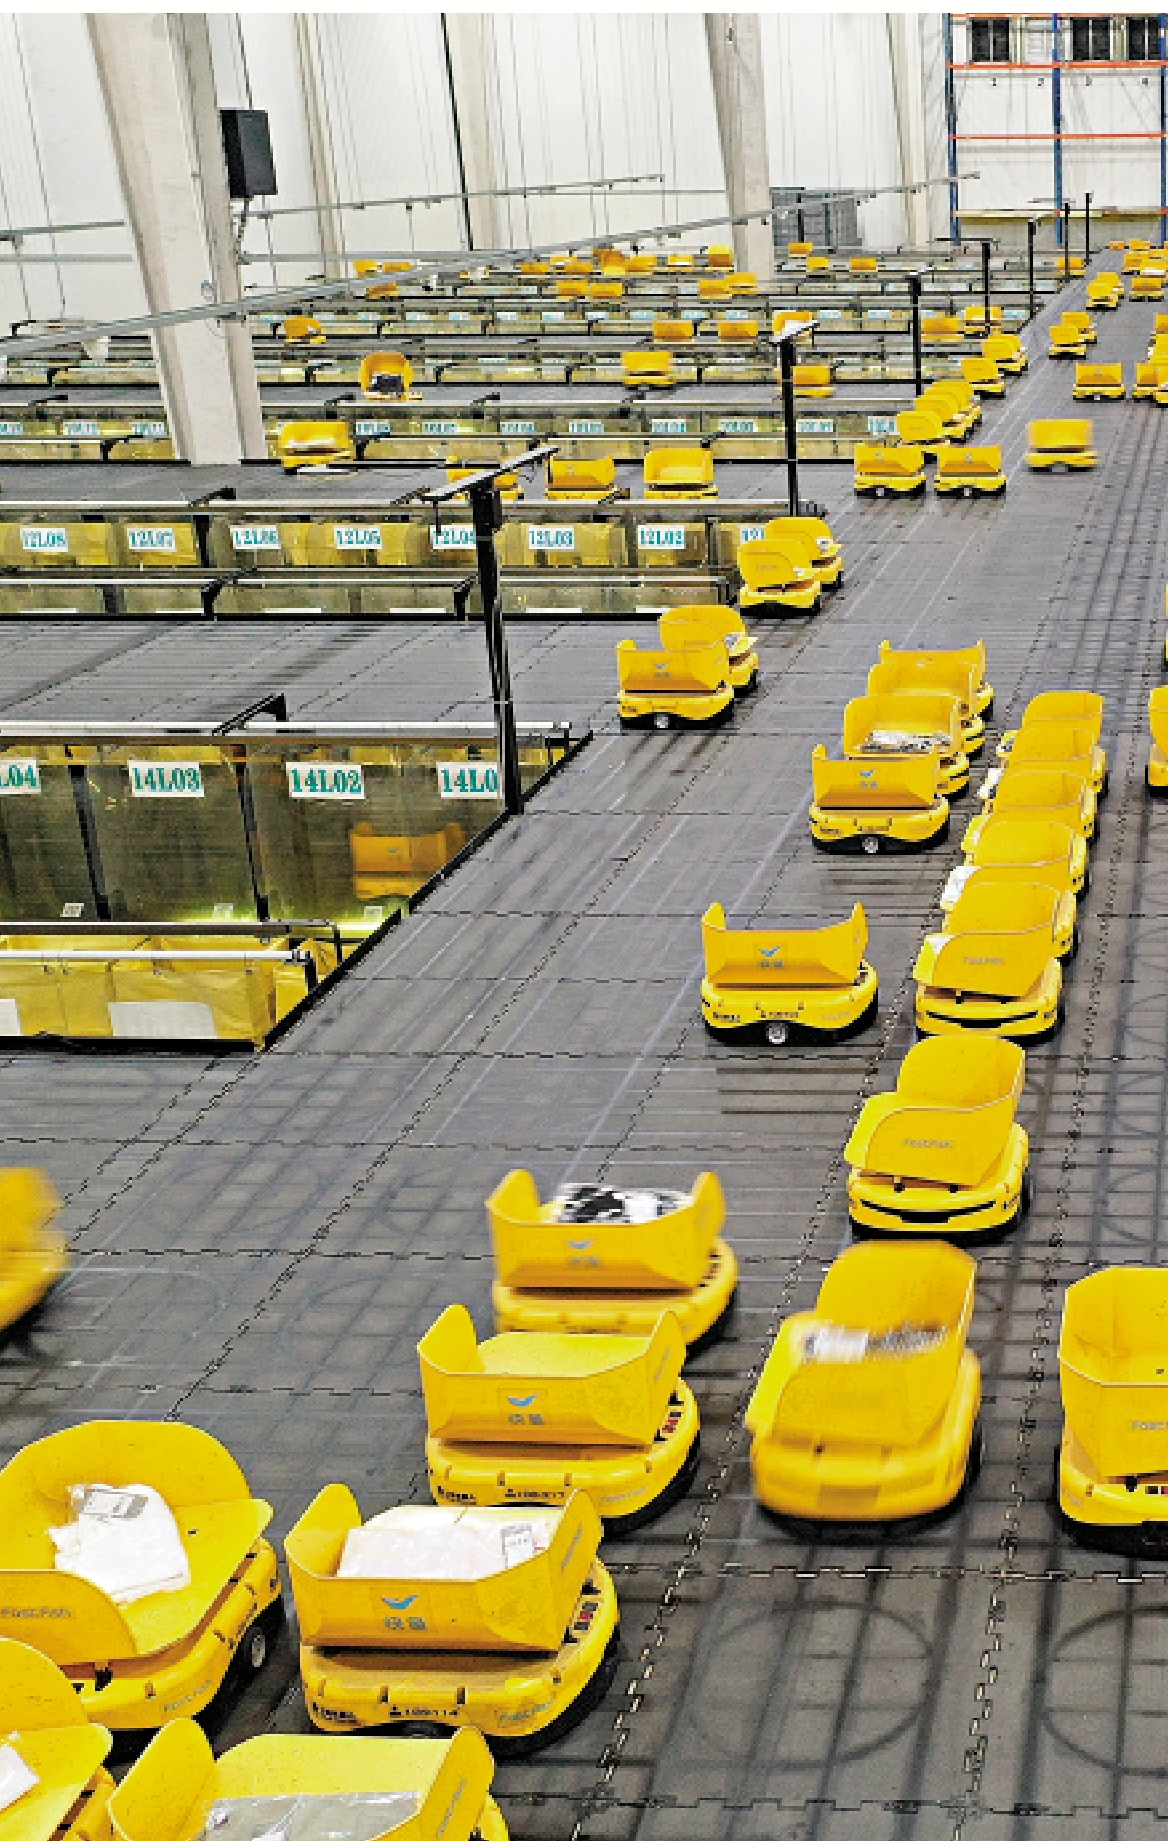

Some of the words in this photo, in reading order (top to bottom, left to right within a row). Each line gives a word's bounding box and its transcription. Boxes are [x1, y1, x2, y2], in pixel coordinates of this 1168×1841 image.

[529, 530, 574, 548] 12L03
[640, 529, 685, 546] 12L02
[132, 767, 201, 793] 14L03
[291, 769, 363, 794] 14L02
[441, 768, 498, 794] 14L0
